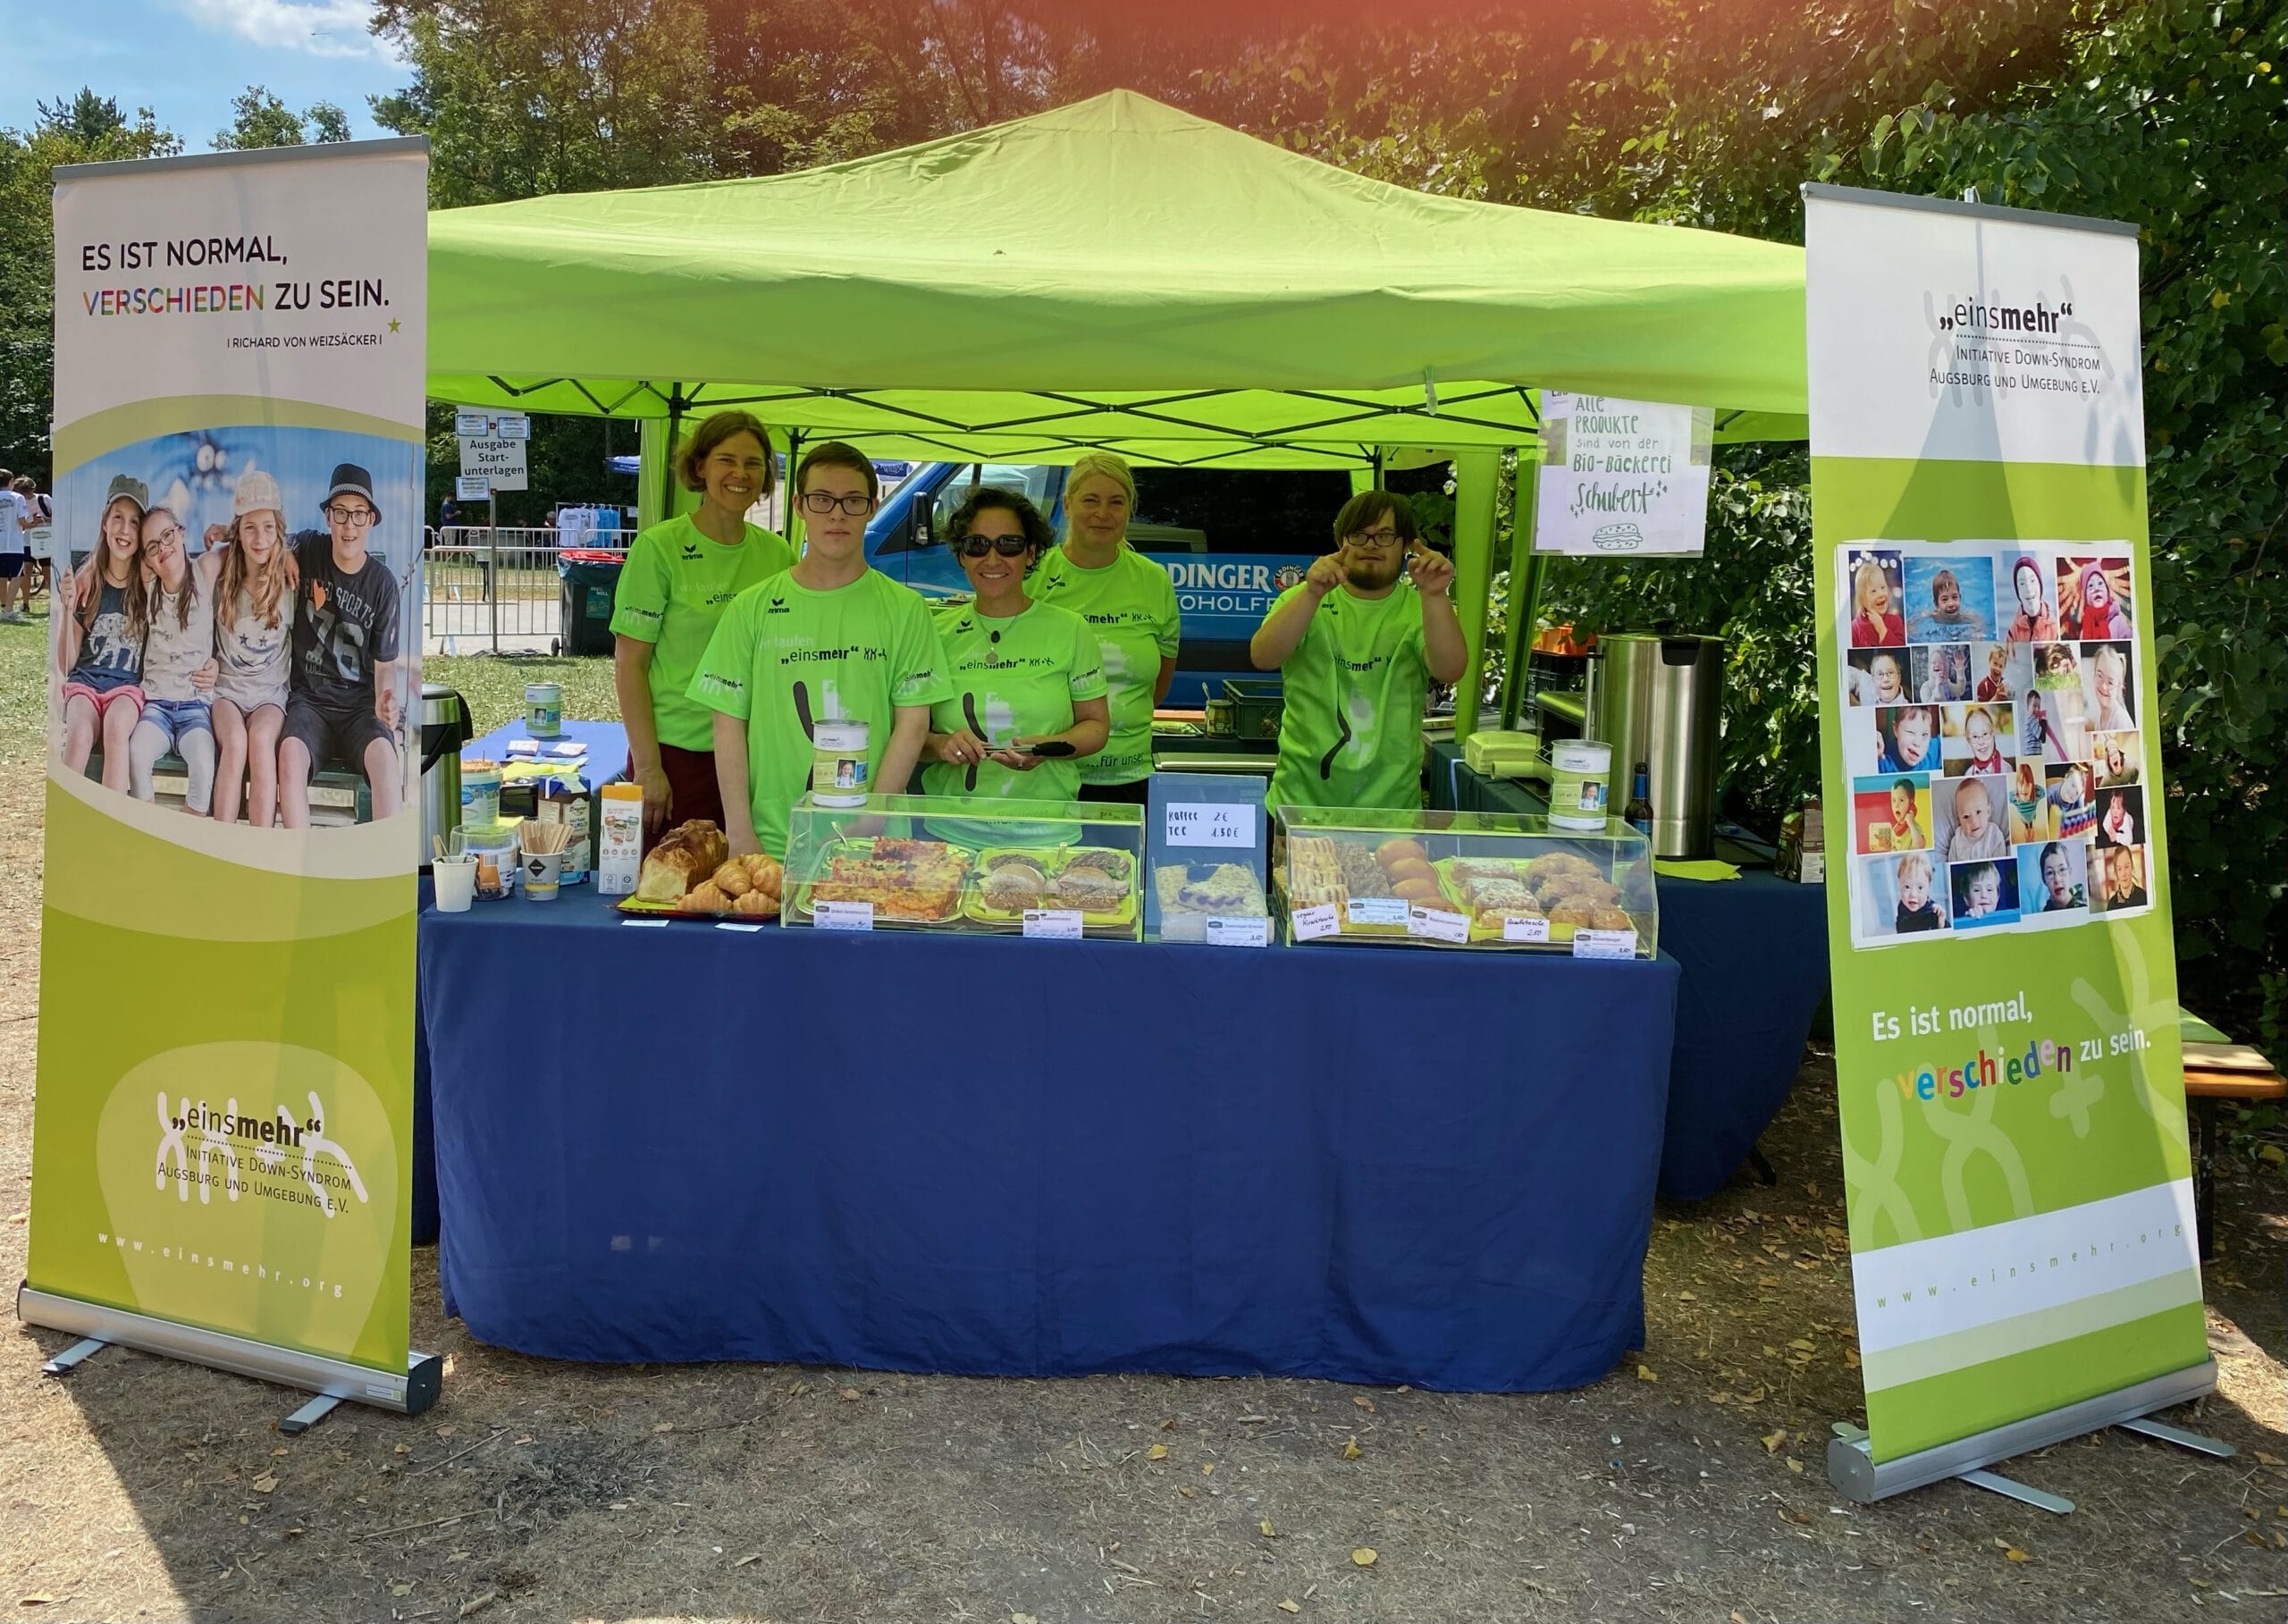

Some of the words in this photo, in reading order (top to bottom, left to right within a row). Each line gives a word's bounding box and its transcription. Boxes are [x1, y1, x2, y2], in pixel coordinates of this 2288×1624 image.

[82, 244, 111, 271] ES
[121, 242, 157, 269] IST
[167, 235, 288, 266] NORMAL,
[82, 284, 264, 316] VERSCHIEDEN
[274, 282, 309, 310] ZU
[320, 279, 390, 308] SEIN.
[283, 335, 307, 348] VON
[470, 440, 516, 451] Ausgabe
[479, 453, 509, 462] Start-
[1577, 438, 1600, 449] sind
[1609, 439, 1630, 449] von
[1638, 438, 1659, 449] der
[465, 466, 524, 477] unterlagen
[1577, 481, 1653, 514] Schubert
[1165, 563, 1273, 593] DINGER
[336, 587, 375, 629] SPORTS
[1872, 1012, 1900, 1041] Es
[1910, 1006, 1940, 1035] ist
[1949, 990, 2032, 1031] normal,
[1897, 1039, 2072, 1100] verschieden
[2080, 1038, 2102, 1062] zu
[2110, 1023, 2151, 1056] sein.
